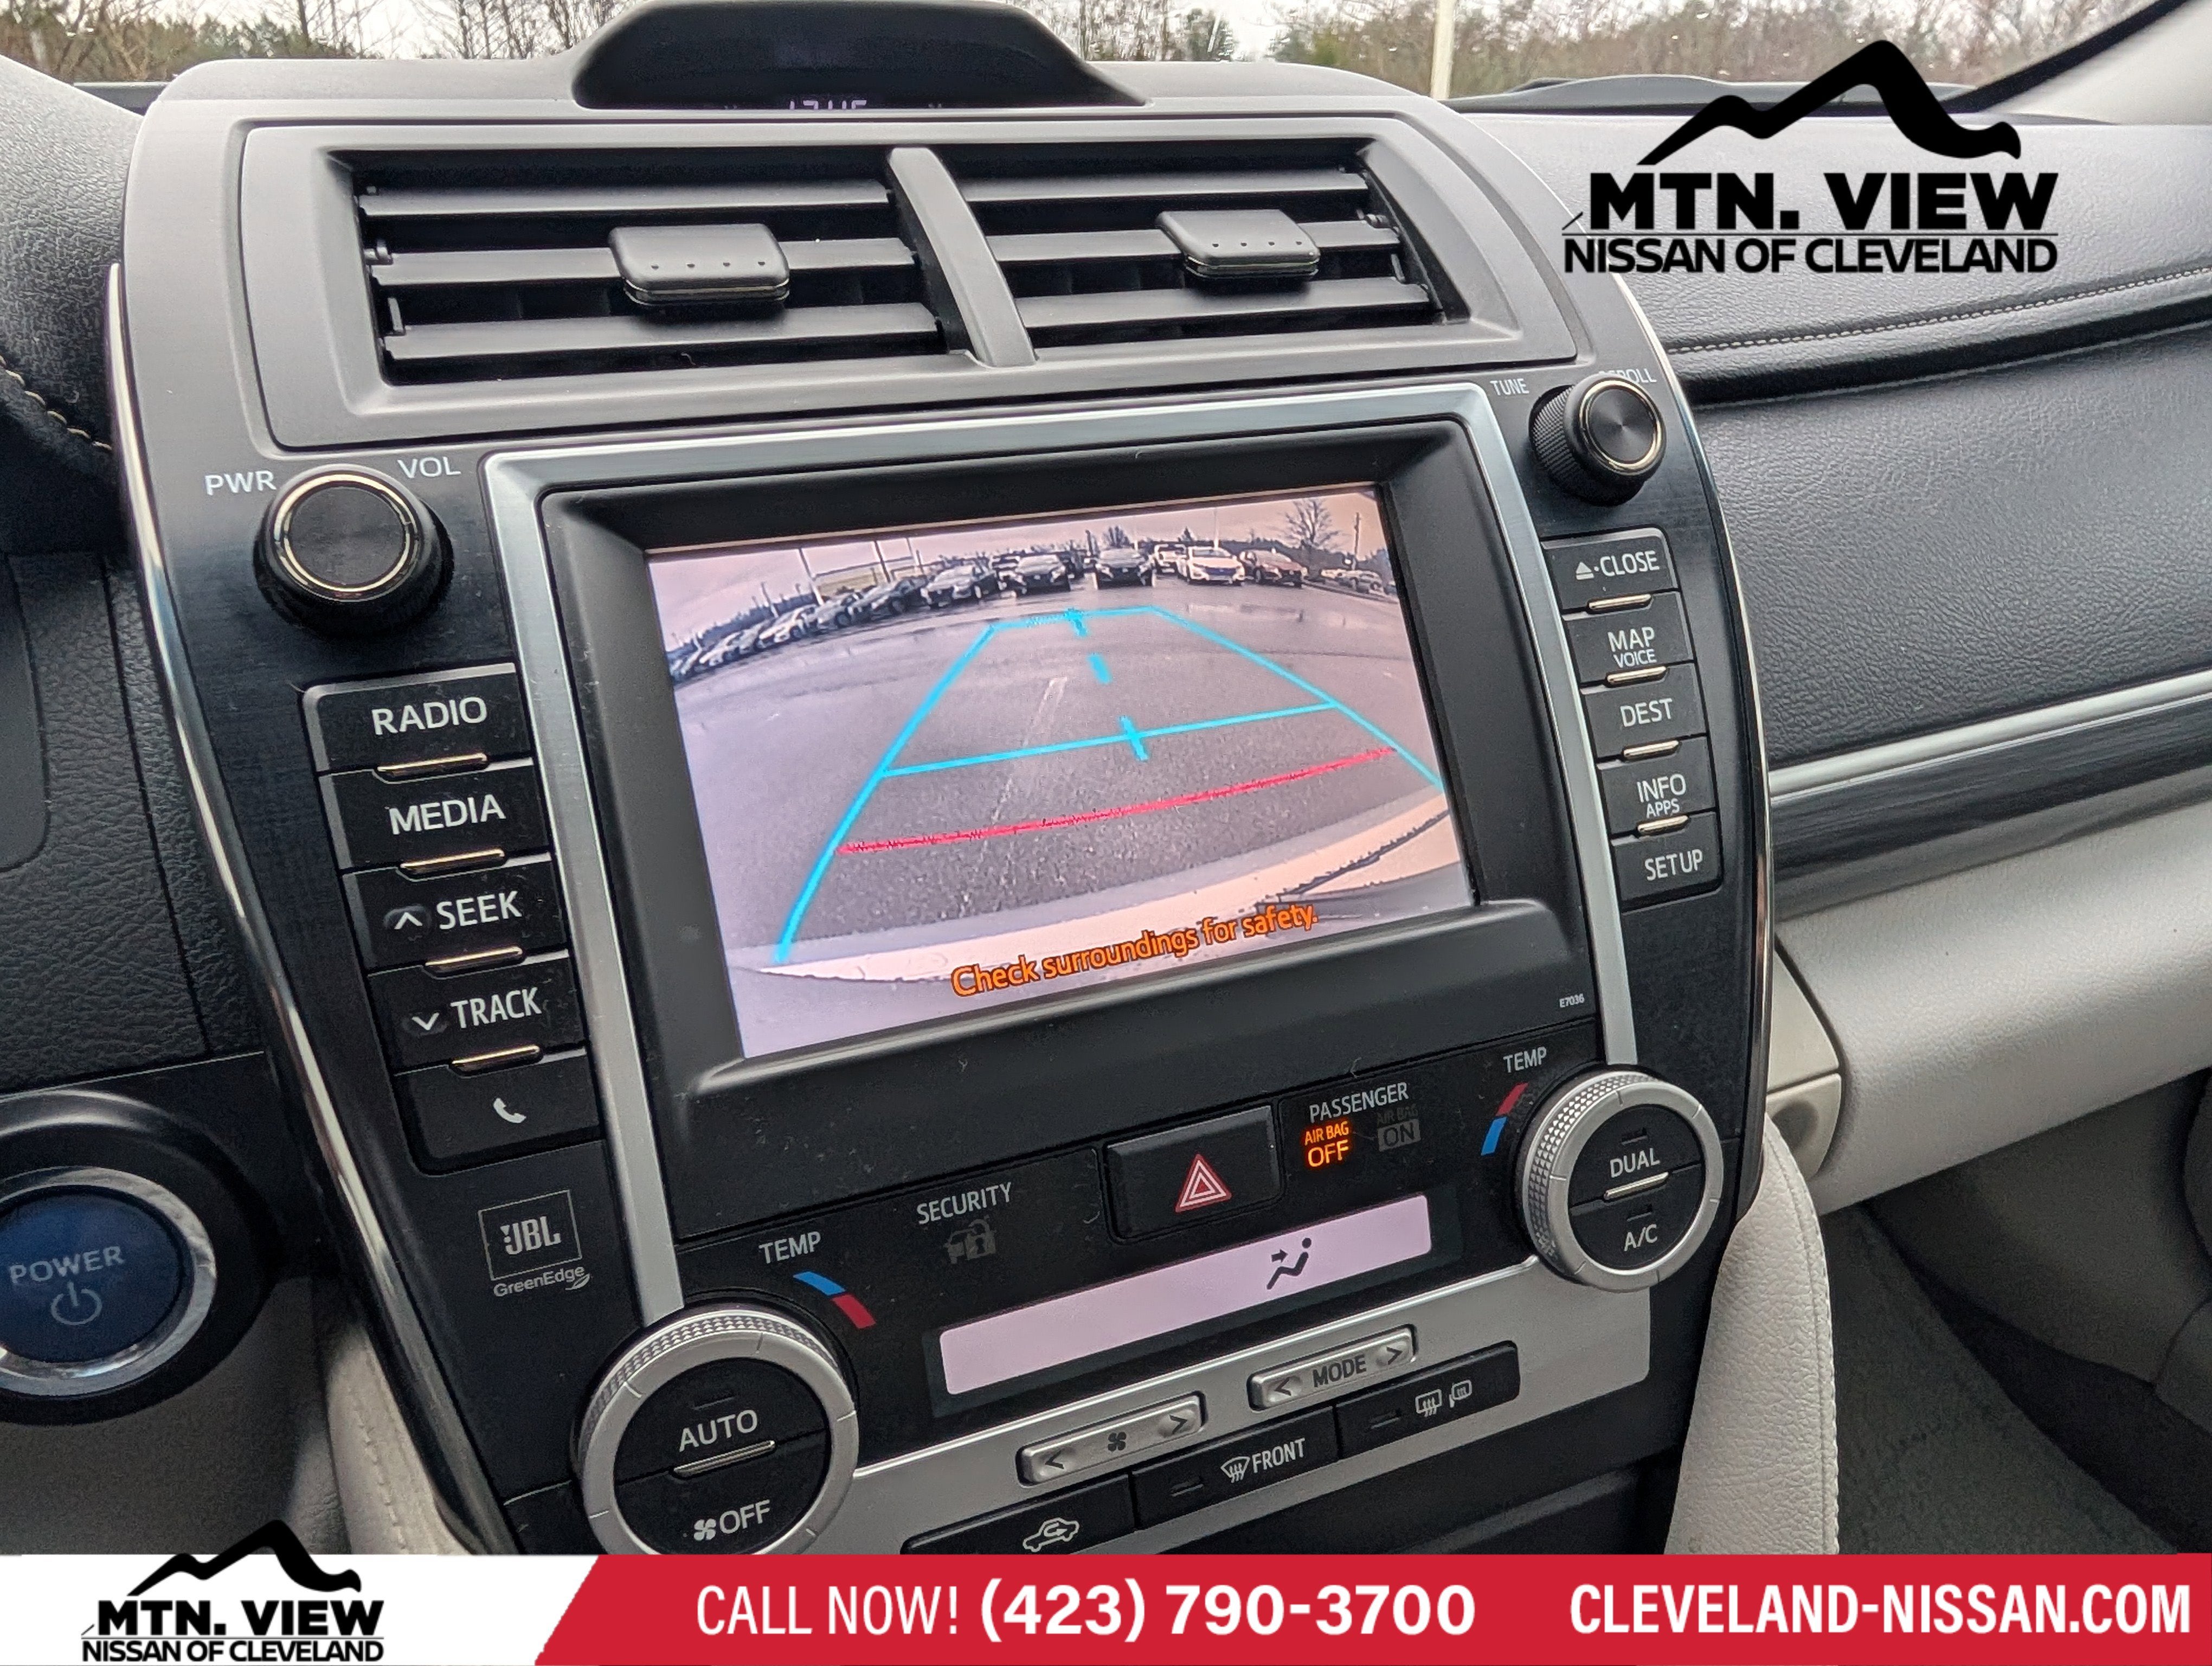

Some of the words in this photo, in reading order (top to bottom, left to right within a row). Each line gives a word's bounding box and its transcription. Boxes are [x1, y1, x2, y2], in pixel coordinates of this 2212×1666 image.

[1490, 378, 1529, 396] TUNE
[204, 470, 277, 496] PWR
[397, 456, 461, 479] VOL
[1599, 550, 1660, 578] CLOSE
[1607, 626, 1655, 652] MAP
[1613, 648, 1657, 668] VOICE
[371, 696, 488, 735] RADIO
[1620, 697, 1673, 728] DEST
[1636, 773, 1687, 803] INFO
[388, 794, 506, 835] MEDIA
[1646, 798, 1680, 818] APPS
[1644, 849, 1703, 881] SETUP
[436, 890, 523, 930] SEEK
[950, 954, 1041, 997] Check
[1041, 930, 1200, 979] surroundings
[1202, 917, 1238, 945] for
[1242, 903, 1319, 938] safety.
[450, 987, 542, 1029] TRACK
[1559, 993, 1585, 1008] E7036
[1503, 1047, 1548, 1073] TEMP
[1309, 1082, 1409, 1124] PASSENGER
[1304, 1127, 1324, 1146] AIR
[1326, 1121, 1349, 1140] BAG
[1383, 1122, 1414, 1146] ON
[1308, 1139, 1349, 1167] OFF
[1610, 1148, 1661, 1178] DUAL
[917, 1182, 1012, 1225] SECURITY
[501, 1216, 561, 1255] JBL
[758, 1231, 821, 1264] TEMP
[1624, 1224, 1658, 1252] A/C
[8, 1246, 126, 1285] POWER
[493, 1266, 585, 1297] GreenEdge
[1313, 1354, 1367, 1387] MODE
[679, 1409, 758, 1452] AUTO
[1252, 1437, 1306, 1473] FRONT
[719, 1500, 770, 1535] OFF
